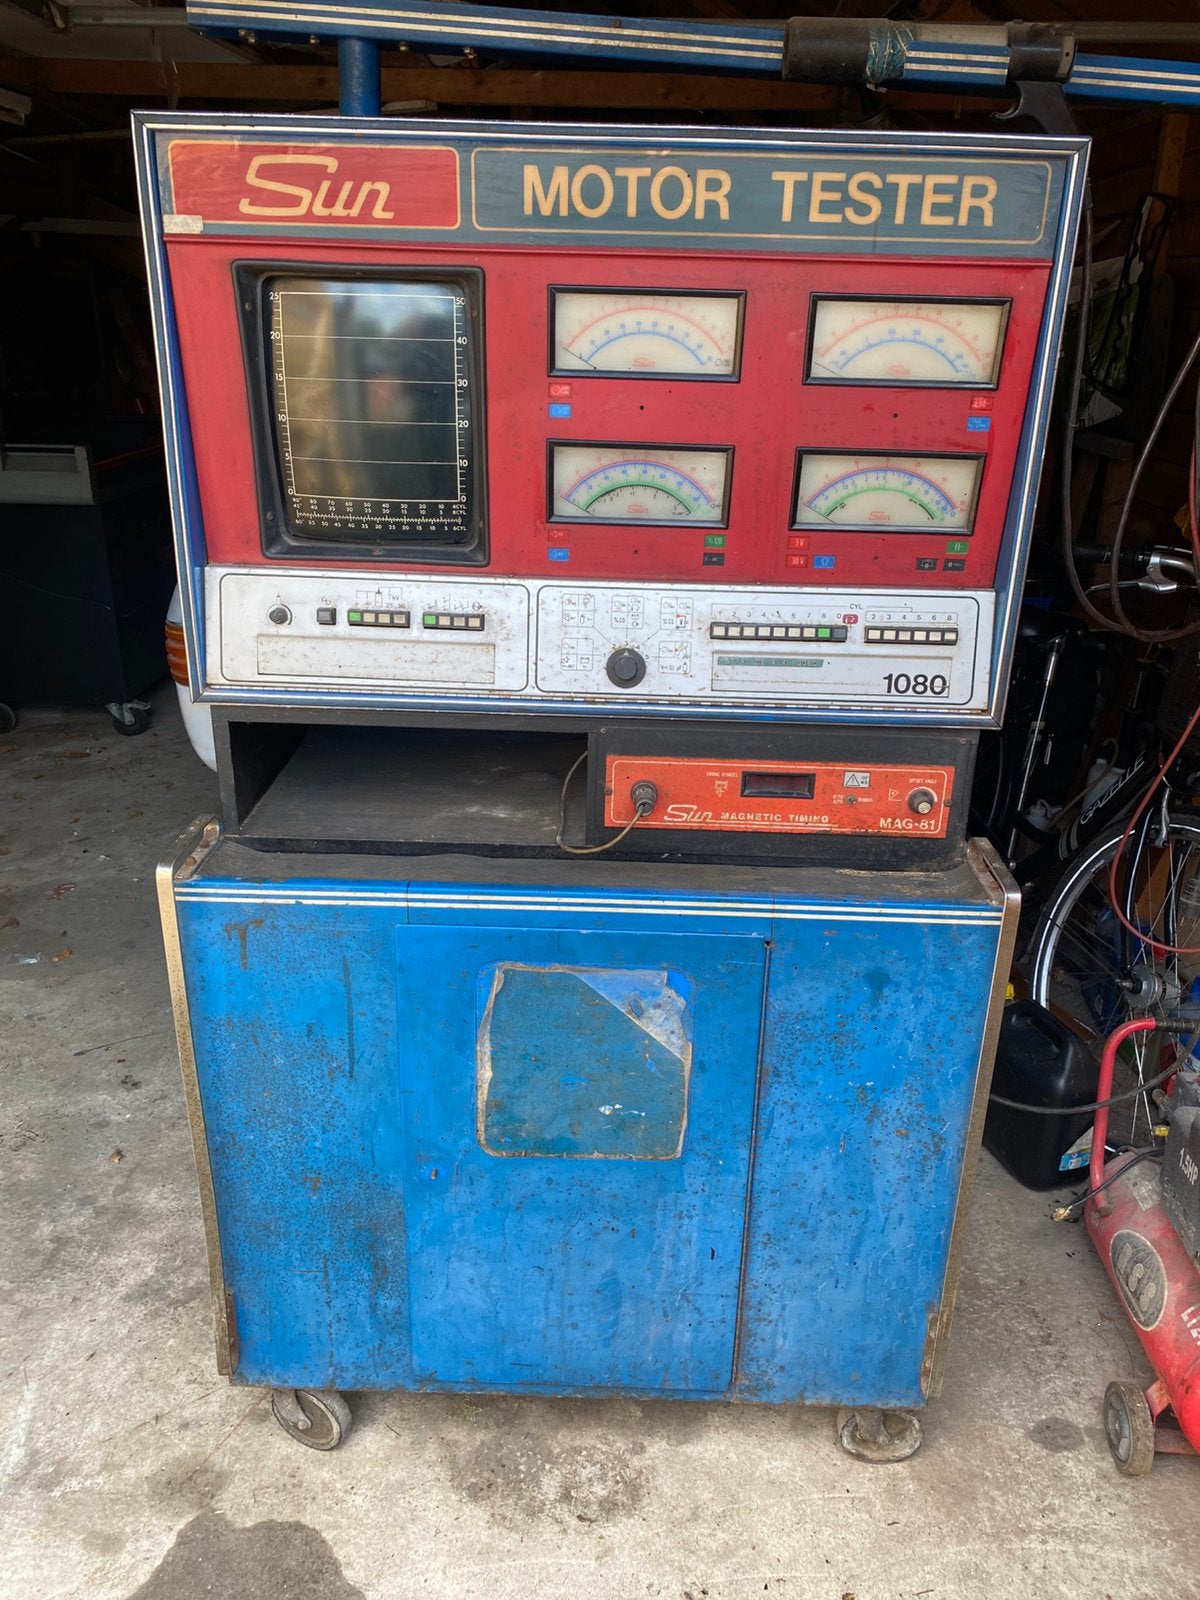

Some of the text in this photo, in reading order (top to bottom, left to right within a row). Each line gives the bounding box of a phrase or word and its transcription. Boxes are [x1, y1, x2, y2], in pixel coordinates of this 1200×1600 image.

[239, 154, 395, 219] Sun
[522, 164, 998, 227] MOTOR TESTER
[269, 292, 280, 300] 25
[456, 298, 466, 306] 50
[270, 332, 280, 340] 20
[457, 336, 468, 344] 40
[275, 373, 283, 381] 15
[458, 380, 468, 388] 30
[278, 414, 286, 422] 10
[458, 420, 468, 428] 20
[883, 673, 947, 695] 1080
[1080, 750, 1146, 824] GAZELLE
[664, 804, 829, 823] Sun MAGNETIC TIMING
[880, 817, 935, 830] MAG-81
